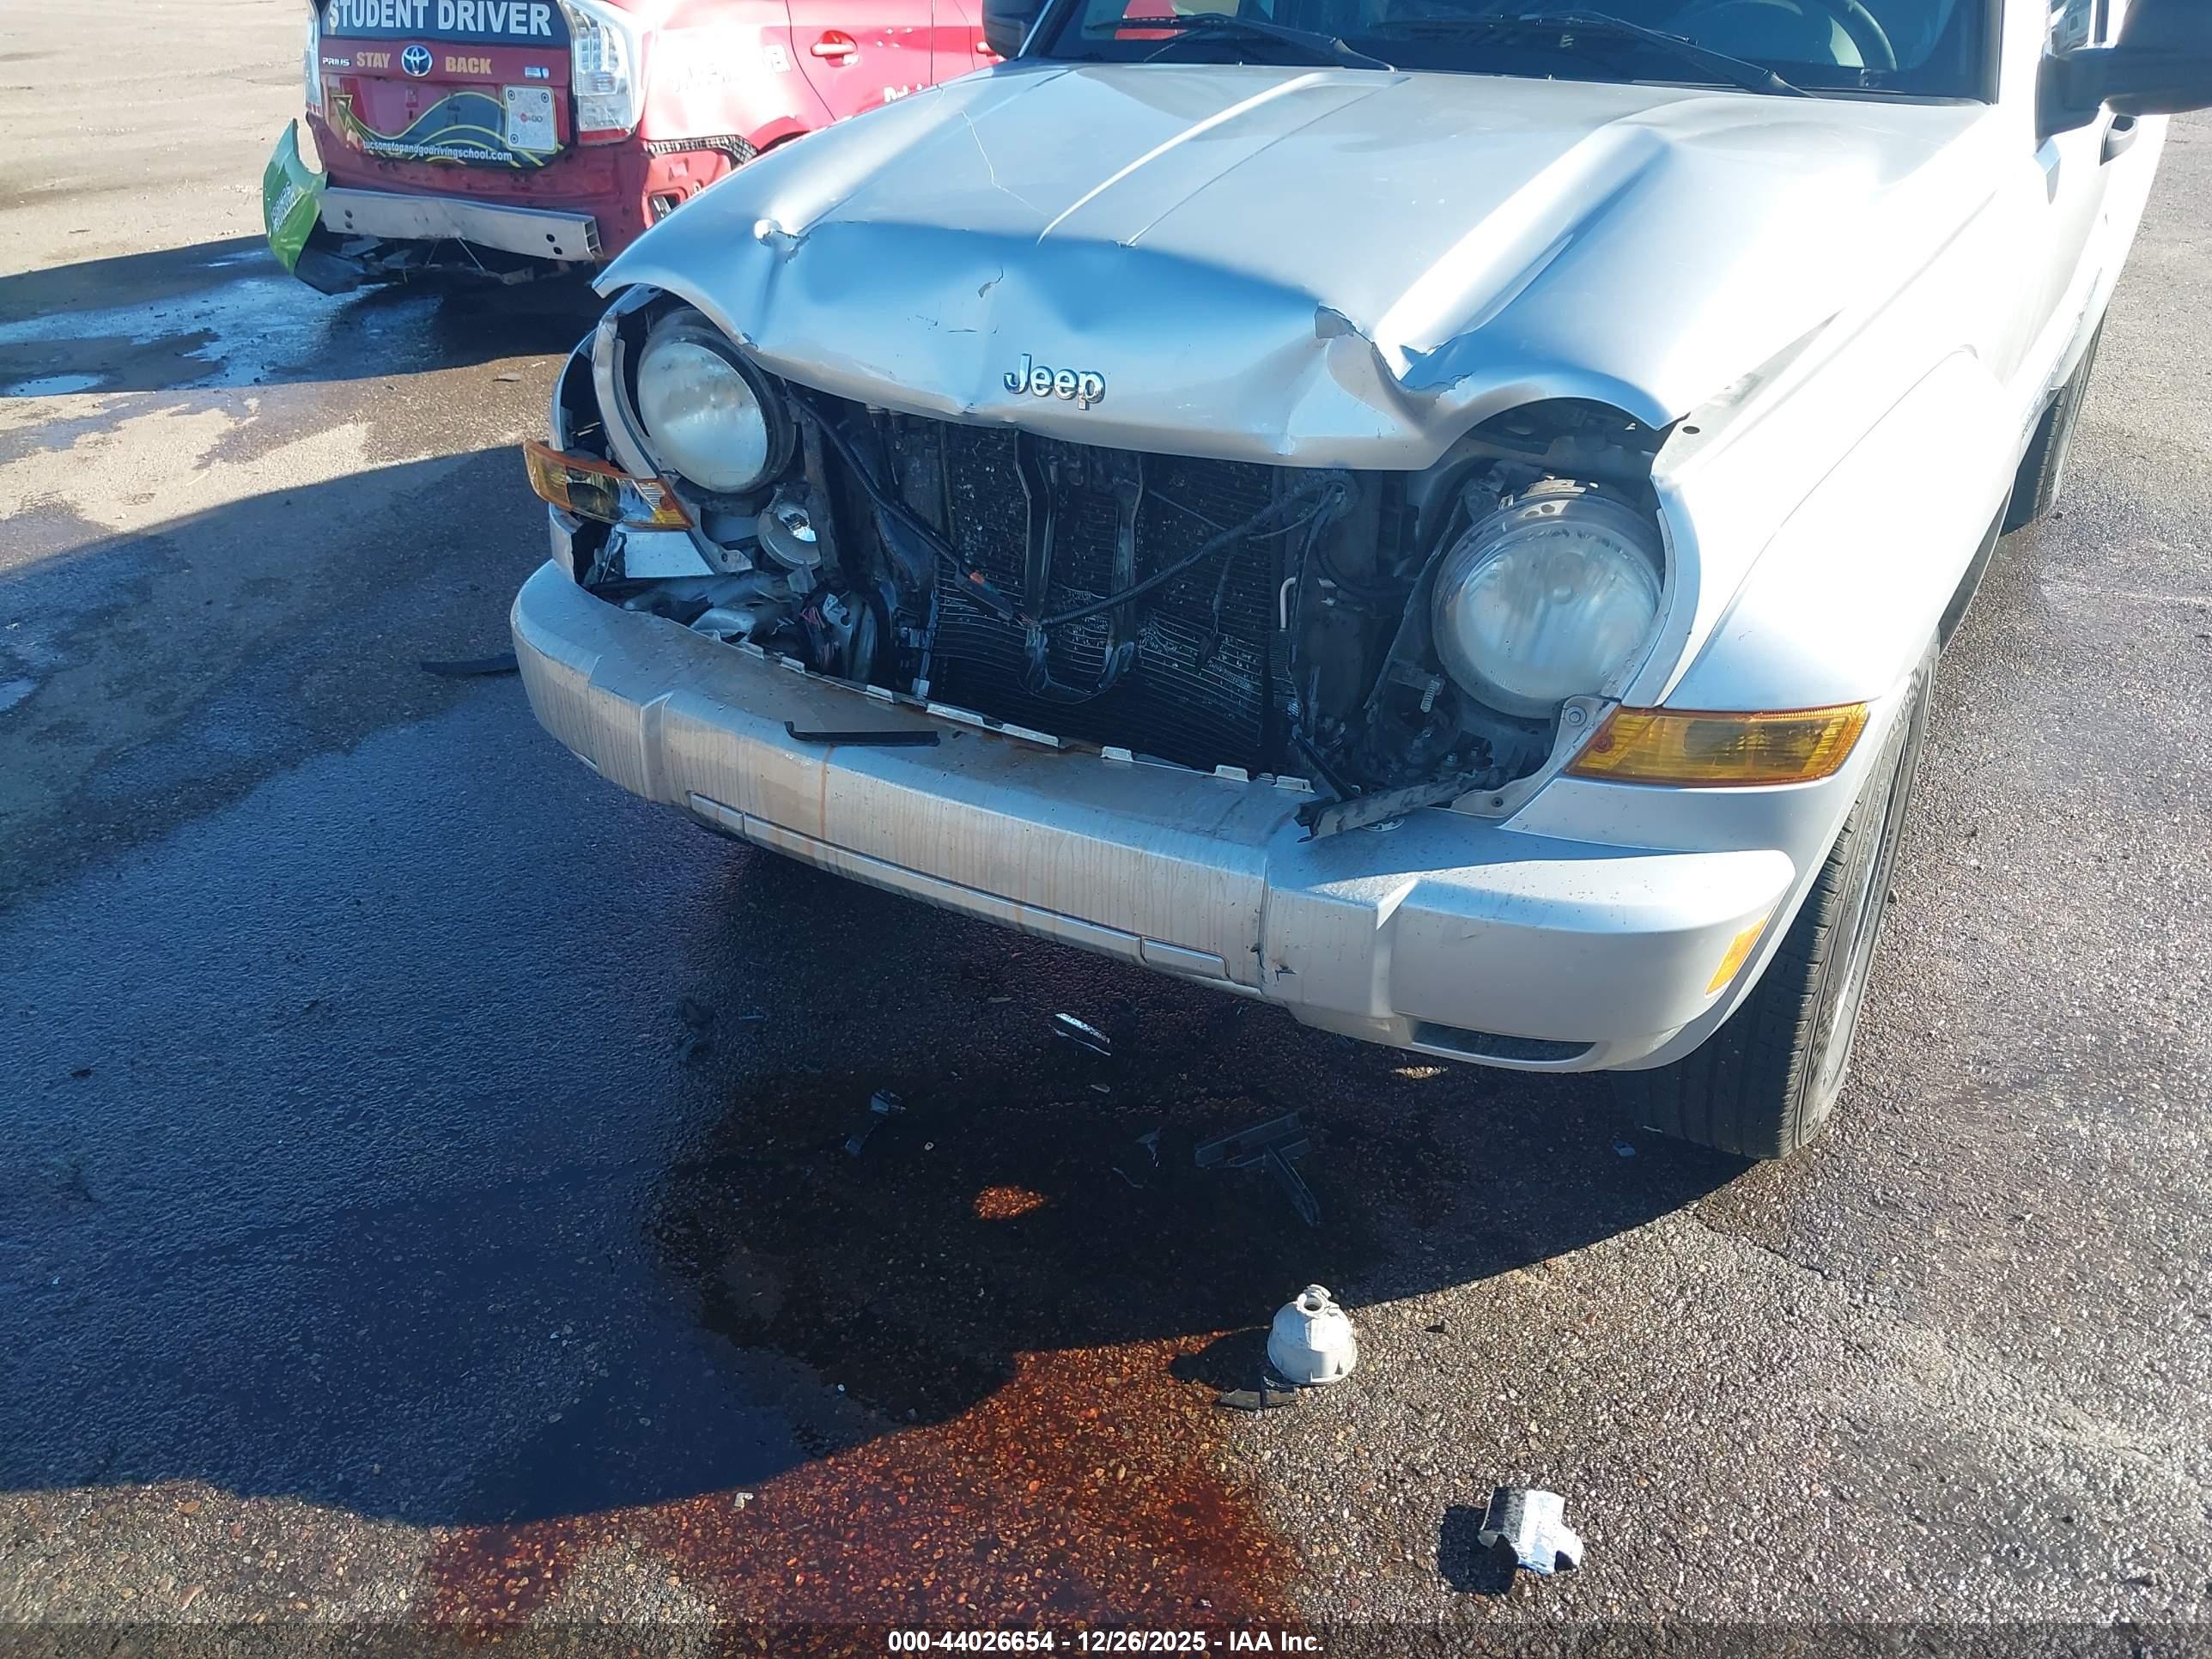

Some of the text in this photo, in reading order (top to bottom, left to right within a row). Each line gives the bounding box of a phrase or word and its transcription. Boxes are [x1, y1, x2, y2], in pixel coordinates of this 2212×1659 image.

[329, 0, 551, 36] STUDENT DRIVER
[356, 52, 492, 75] STAY BACK
[362, 139, 513, 162] tucsonstopandgodrivingschool.com
[1004, 353, 1105, 410] Jeep
